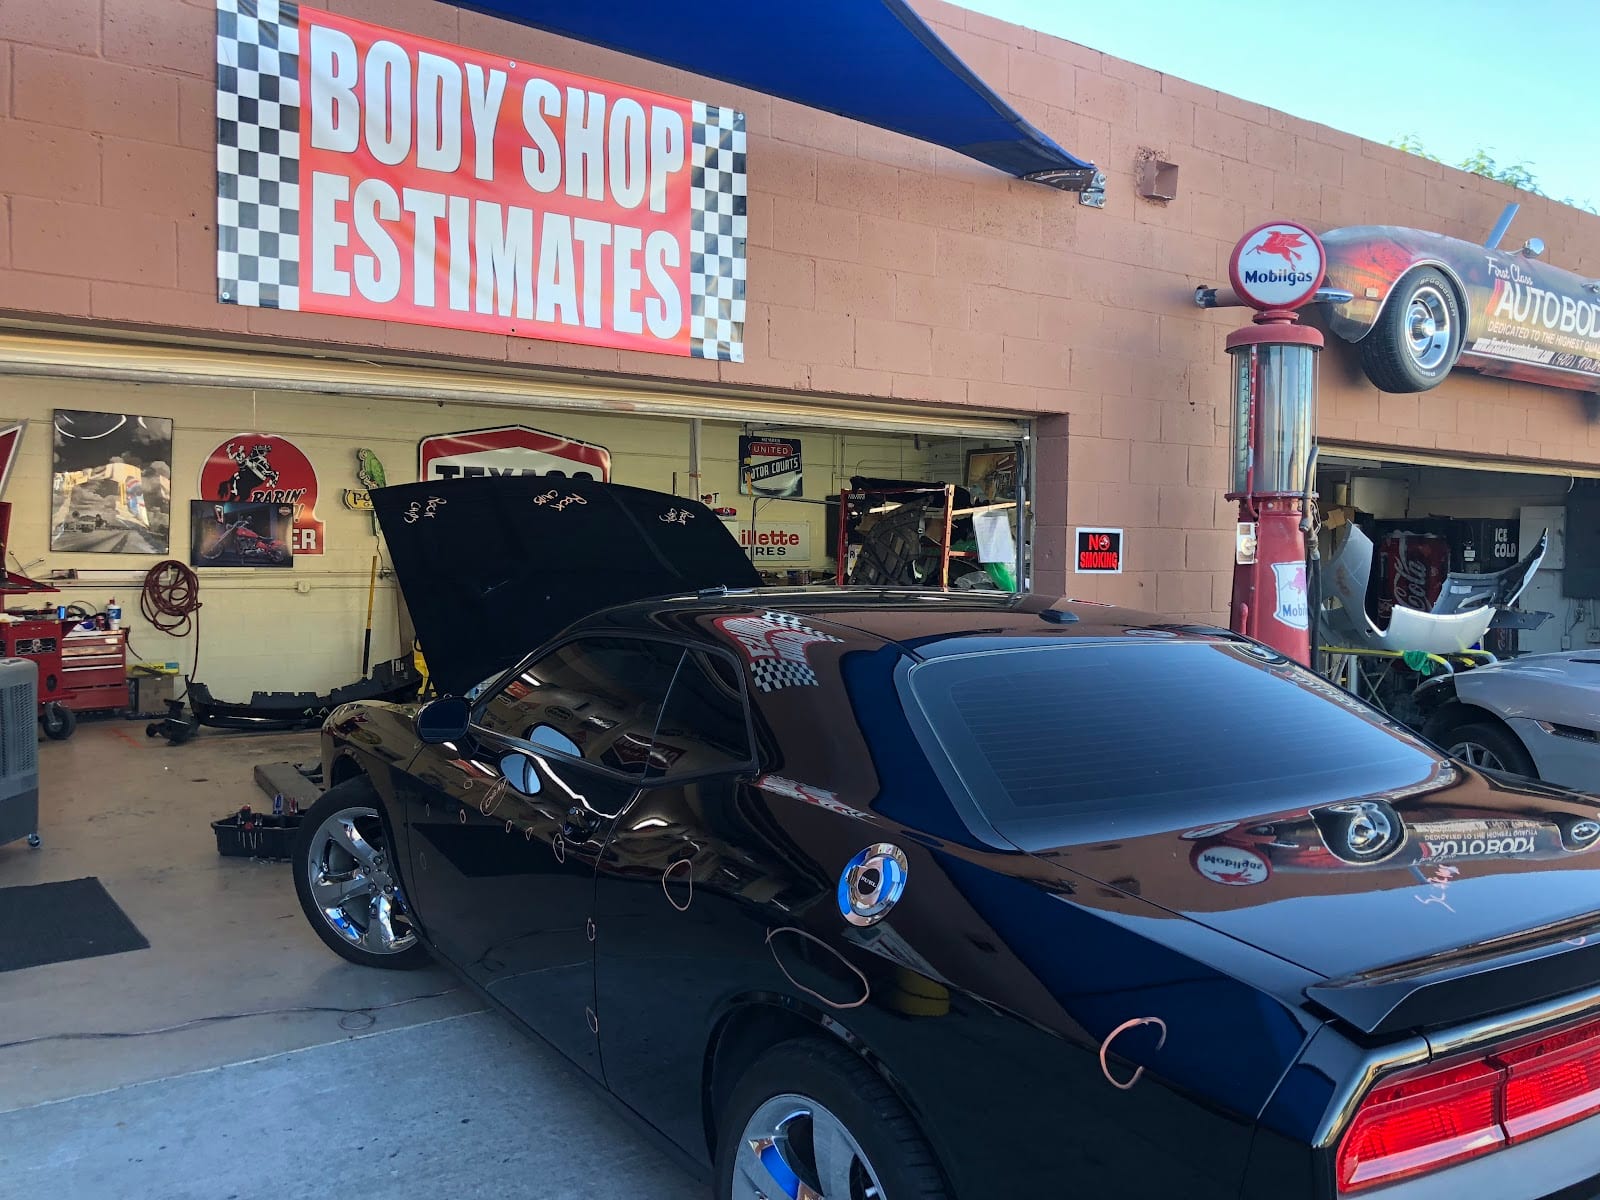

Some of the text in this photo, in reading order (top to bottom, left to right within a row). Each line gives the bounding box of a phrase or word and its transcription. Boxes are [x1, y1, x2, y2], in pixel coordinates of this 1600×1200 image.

[309, 24, 685, 214] BODY SHOP
[311, 170, 683, 340] ESTIMATES
[1244, 269, 1313, 286] Mobilgas
[1488, 320, 1530, 340] DEDICATED
[1531, 327, 1540, 342] TO
[1541, 330, 1555, 345] THE
[1555, 332, 1584, 350] HIGHEST
[753, 446, 789, 455] UNITED
[771, 457, 798, 474] COURTS
[740, 529, 800, 546] illette
[1088, 534, 1110, 550] NO
[1495, 528, 1508, 541] ICE
[1494, 543, 1516, 558] COLD
[1080, 552, 1118, 568] SMOKING
